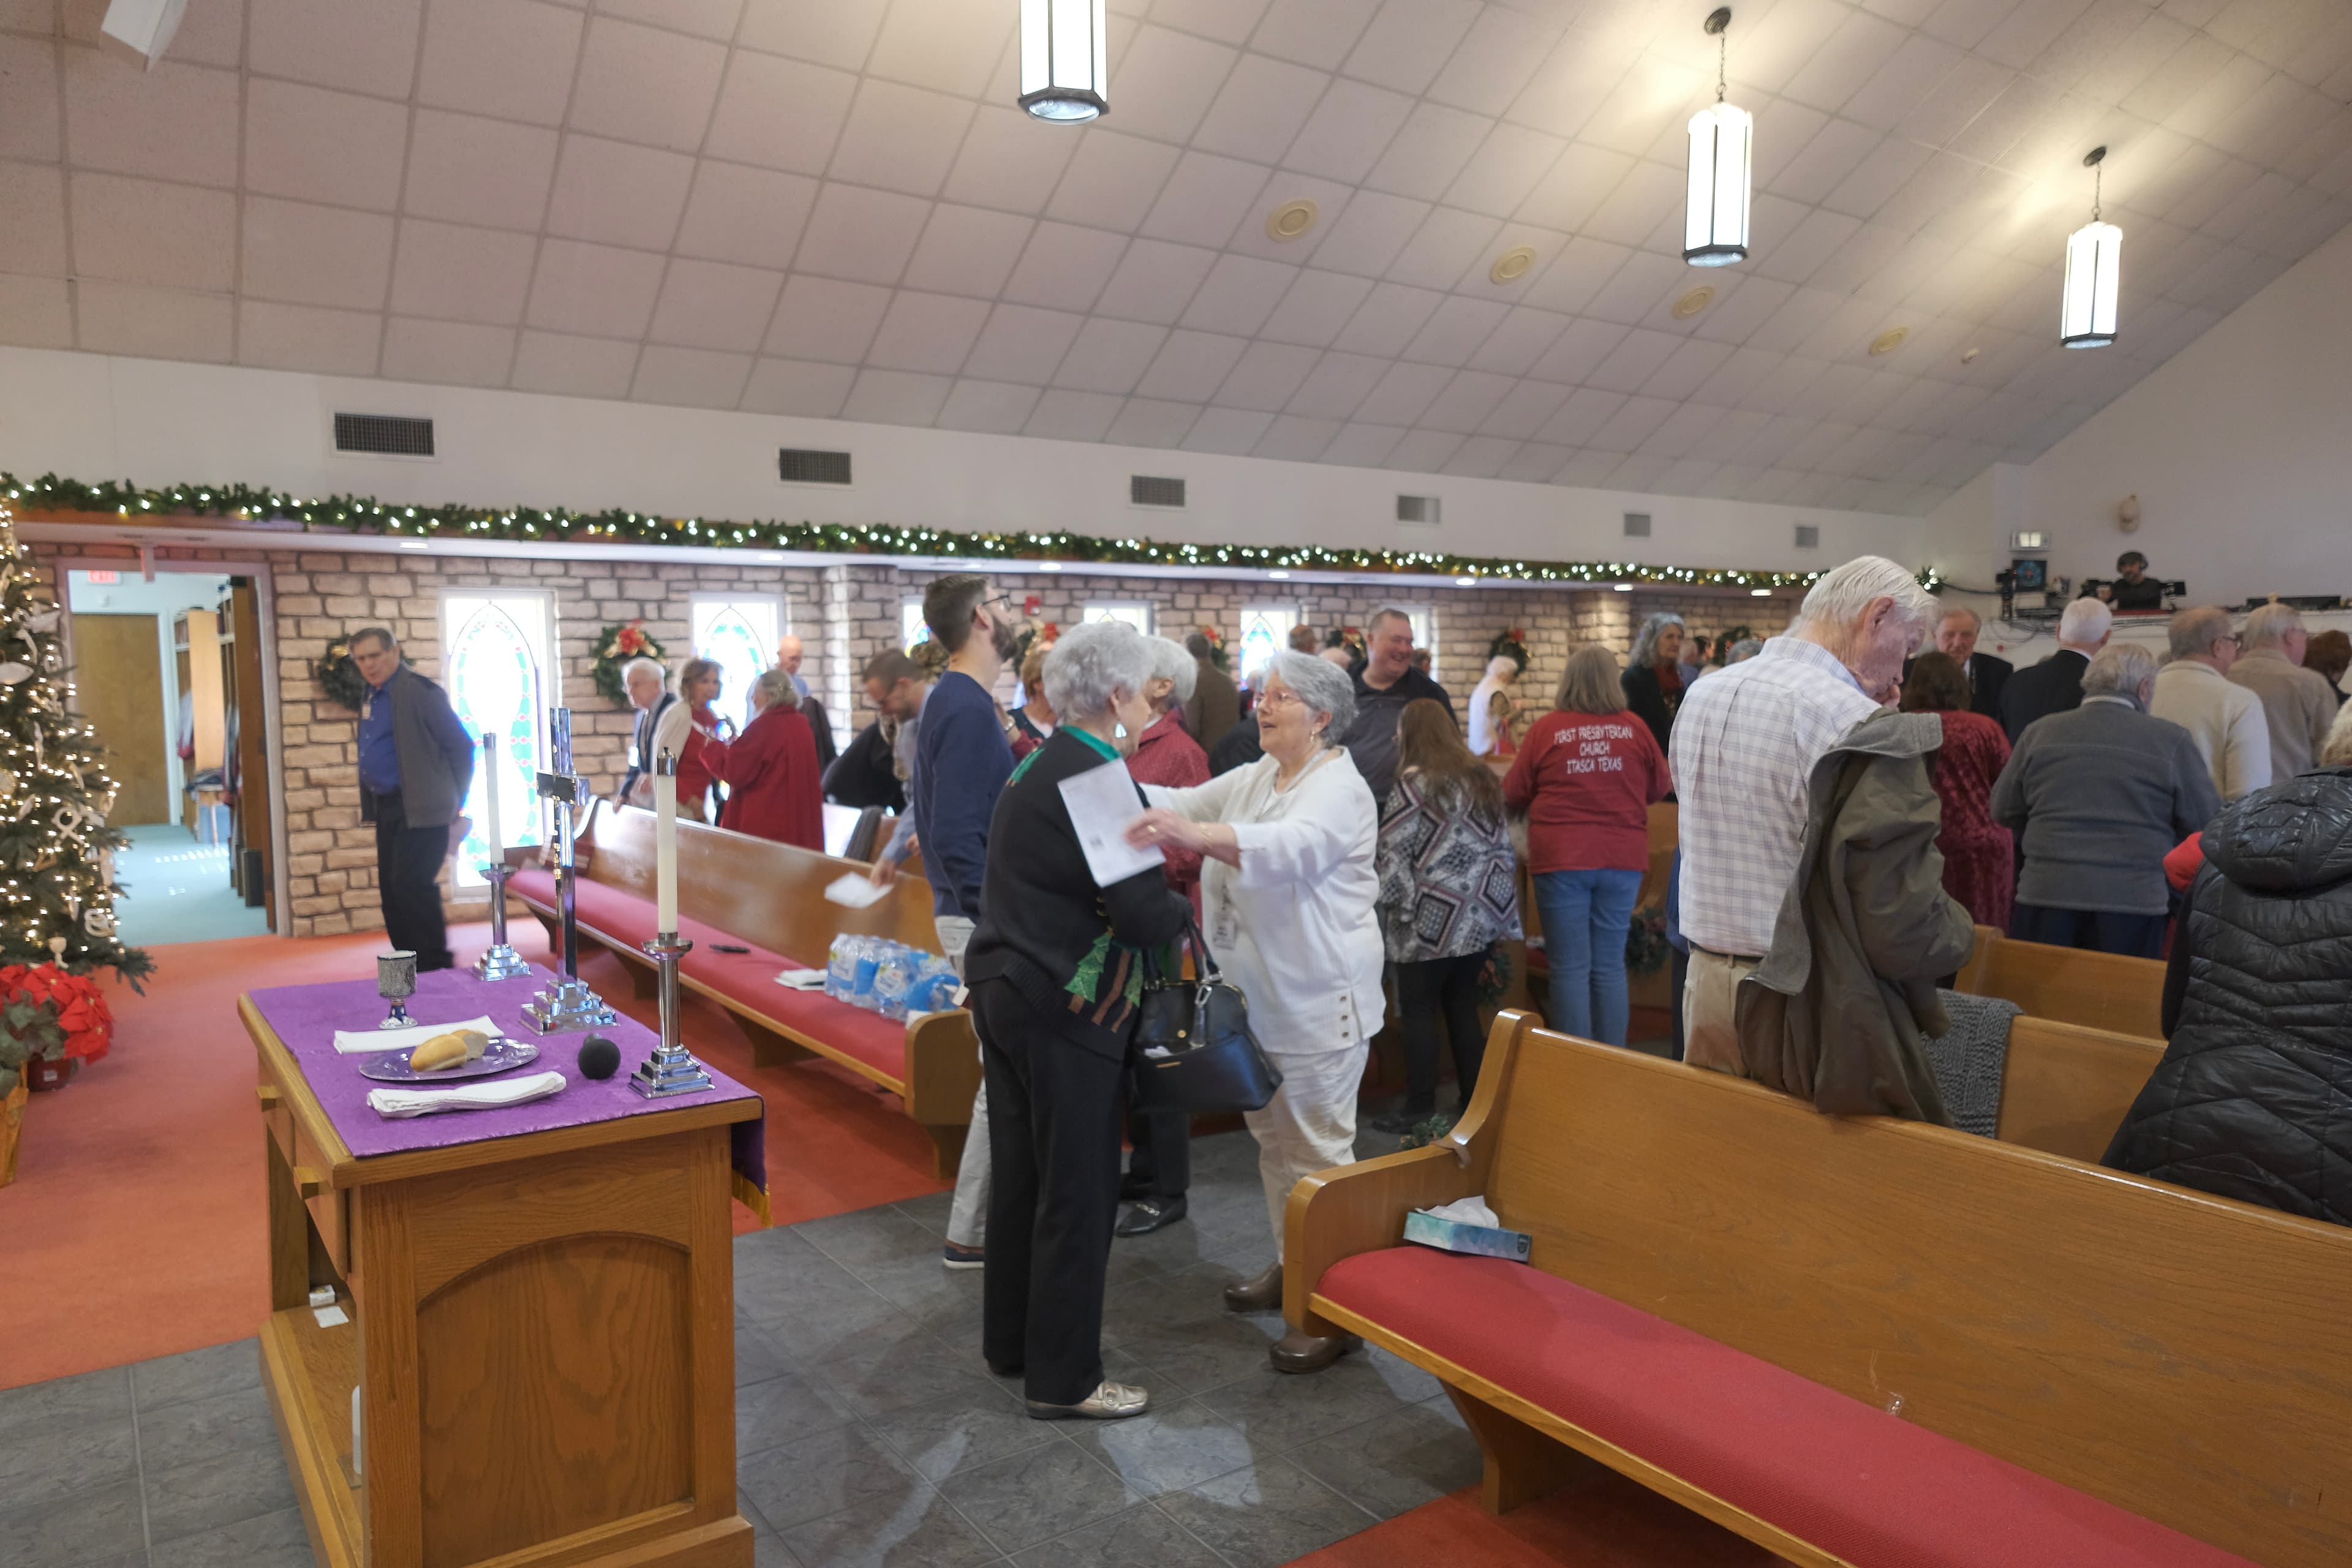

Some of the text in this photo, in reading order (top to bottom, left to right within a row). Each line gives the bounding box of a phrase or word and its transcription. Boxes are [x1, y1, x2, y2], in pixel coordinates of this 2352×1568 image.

[1554, 725, 1633, 744] FIRST PRESBYTERIAN
[1580, 742, 1610, 756] CHURCH
[1567, 756, 1622, 774] ITASCA TEXAS
